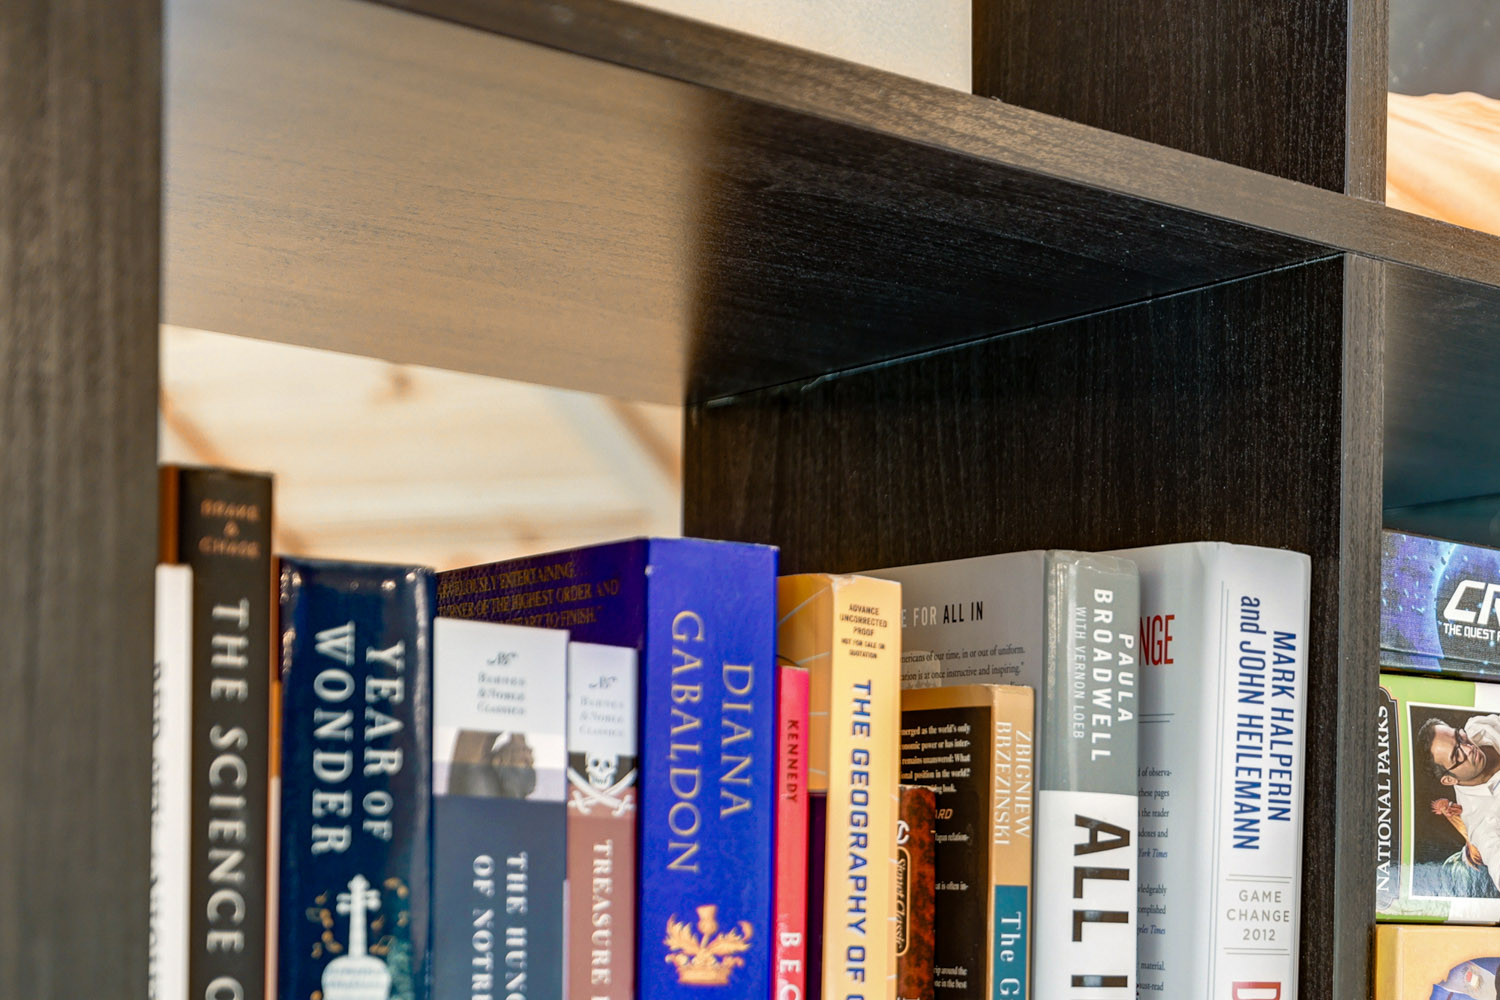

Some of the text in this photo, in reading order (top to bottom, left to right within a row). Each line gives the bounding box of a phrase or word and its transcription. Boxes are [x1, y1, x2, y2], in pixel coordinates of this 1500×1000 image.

[211, 598, 250, 702] THE
[913, 601, 983, 627] FOR ALL IN
[1443, 623, 1462, 636] THE
[1463, 625, 1495, 642] QUEST
[850, 679, 872, 738] THE
[1072, 606, 1087, 739] WITH VERNON LOEB
[1091, 587, 1113, 762] BROADWELL
[1117, 632, 1134, 723] PAULA
[1232, 595, 1267, 851] and JOHN HEILEMANN
[1268, 631, 1297, 822] MARK HALPERIN
[311, 620, 357, 855] WONDER
[361, 641, 406, 843] YEAR OF
[667, 609, 704, 874] GABALDON
[719, 661, 754, 821] DIANA
[785, 719, 800, 803] KENNEDY
[994, 721, 1013, 846] BRZEZINSKI
[1015, 731, 1033, 839] ZBIGNIEW
[206, 724, 247, 954] SCIENCE
[846, 749, 870, 939] GEOGRAPHY
[1377, 705, 1391, 892] NATIONAL PARKS
[472, 855, 495, 897] OF
[506, 851, 528, 915] THE
[591, 839, 613, 985] TREASURE
[1072, 814, 1130, 943] ALL
[1225, 907, 1290, 923] CHANGE
[1238, 889, 1282, 903] GAME
[845, 946, 866, 983] OF
[999, 912, 1022, 962] The
[1242, 928, 1276, 941] 2012
